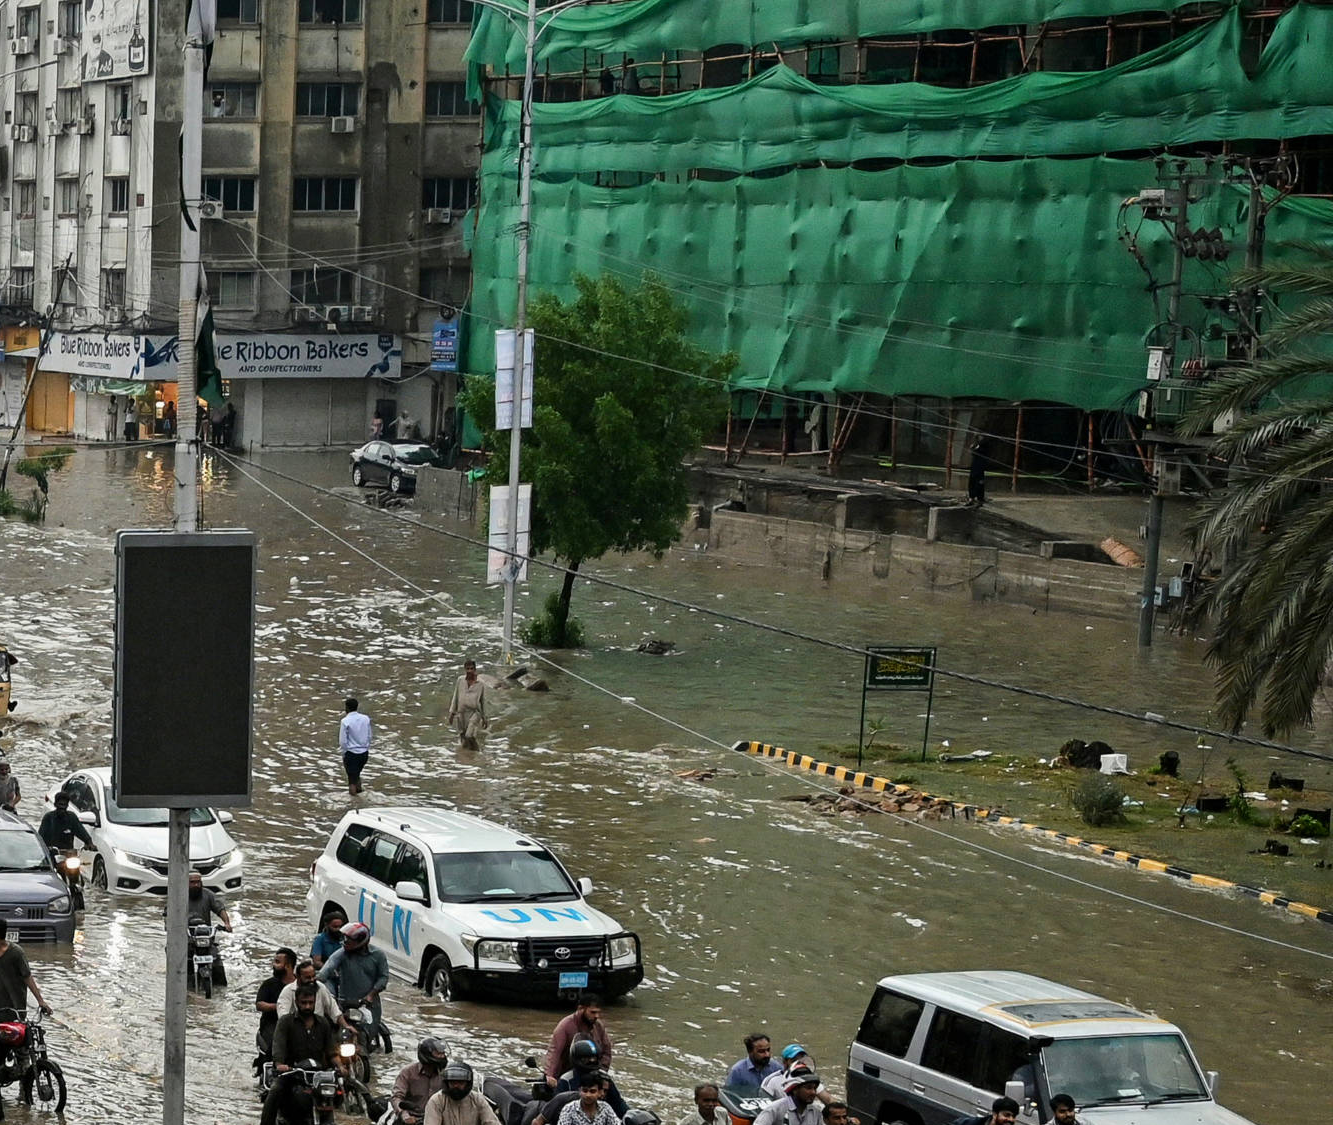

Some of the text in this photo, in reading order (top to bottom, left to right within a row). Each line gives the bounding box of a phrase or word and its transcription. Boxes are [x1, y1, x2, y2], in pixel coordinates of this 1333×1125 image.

[61, 336, 131, 358] Blue Ribbon Bakers
[237, 341, 300, 362] Ribbon
[306, 340, 369, 360] Bakers
[239, 364, 322, 373] AND CONFECTIONERS
[481, 907, 589, 924] UN
